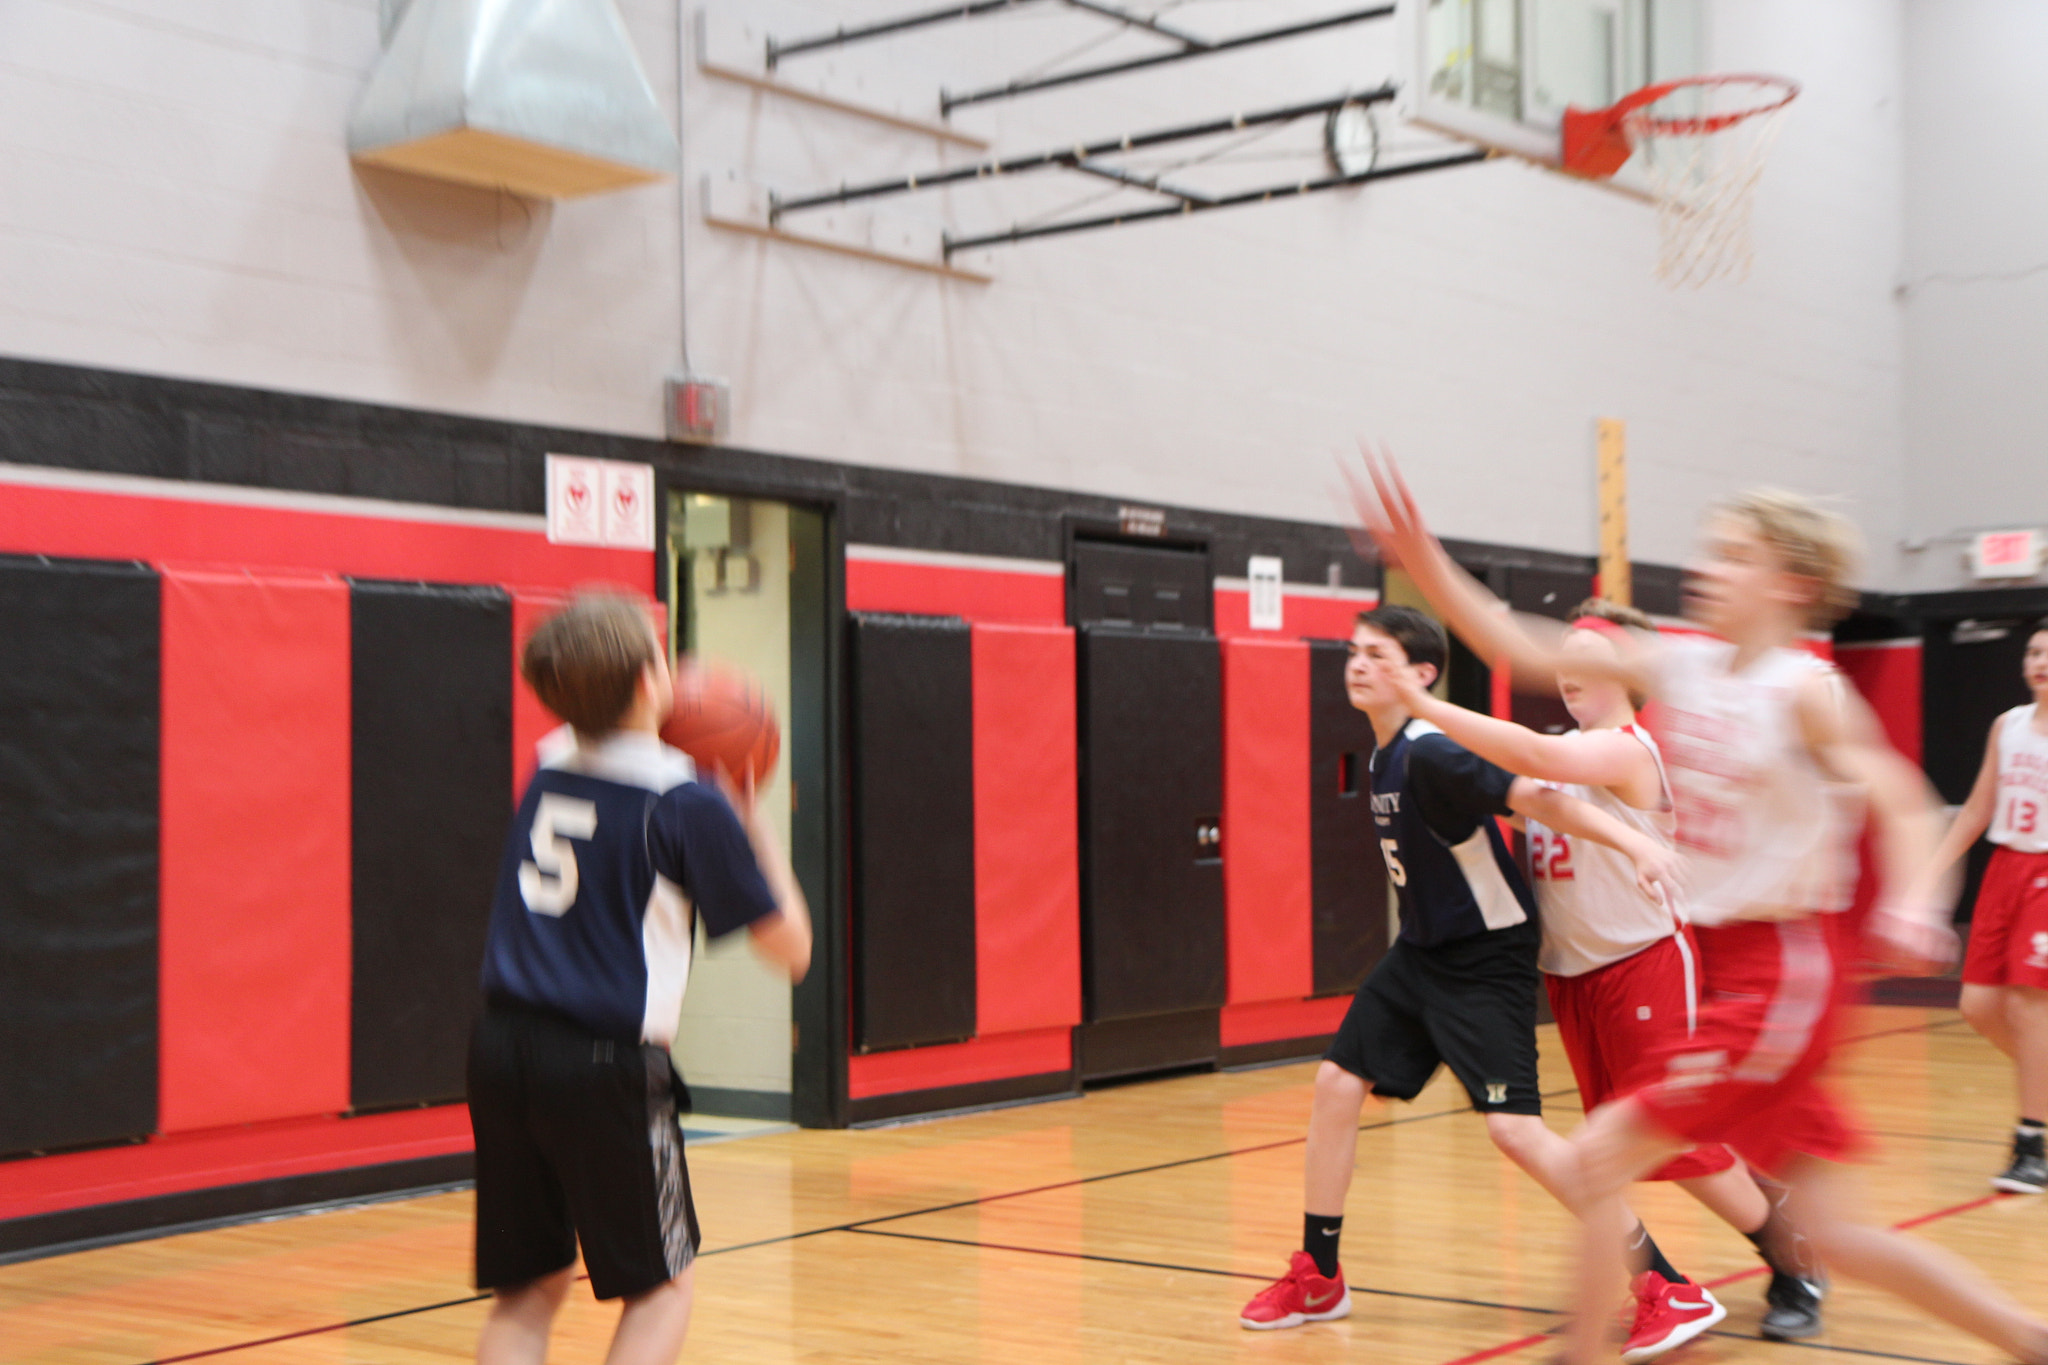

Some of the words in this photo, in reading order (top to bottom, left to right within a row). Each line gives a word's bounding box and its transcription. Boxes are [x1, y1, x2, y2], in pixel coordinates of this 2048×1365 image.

[2006, 798, 2038, 834] 13
[518, 792, 598, 918] 5
[1532, 833, 1575, 880] 22
